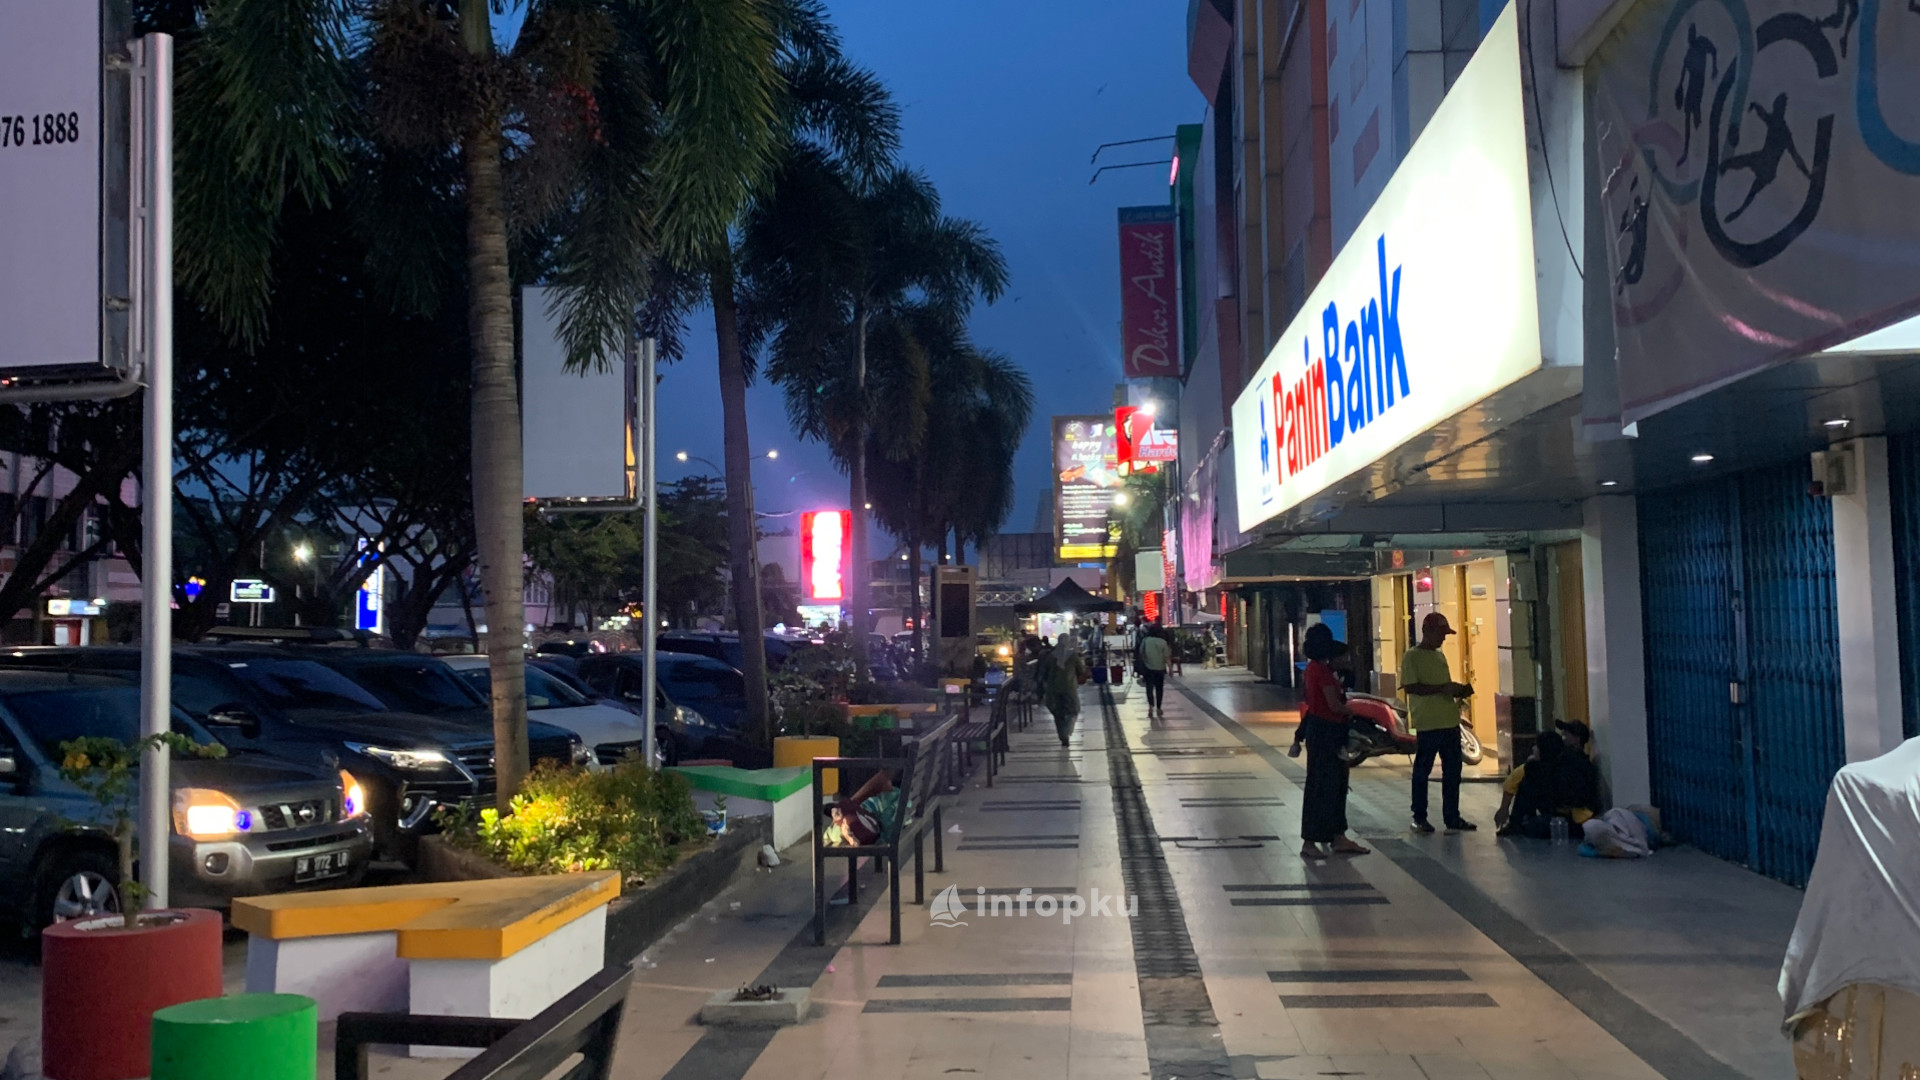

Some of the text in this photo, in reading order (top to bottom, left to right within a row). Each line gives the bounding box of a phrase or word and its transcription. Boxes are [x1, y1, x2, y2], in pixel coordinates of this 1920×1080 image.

[0, 110, 79, 147] 76 1888
[1128, 231, 1168, 305] Antik
[1131, 303, 1170, 372] Dekor
[1272, 232, 1410, 486] PaninBank
